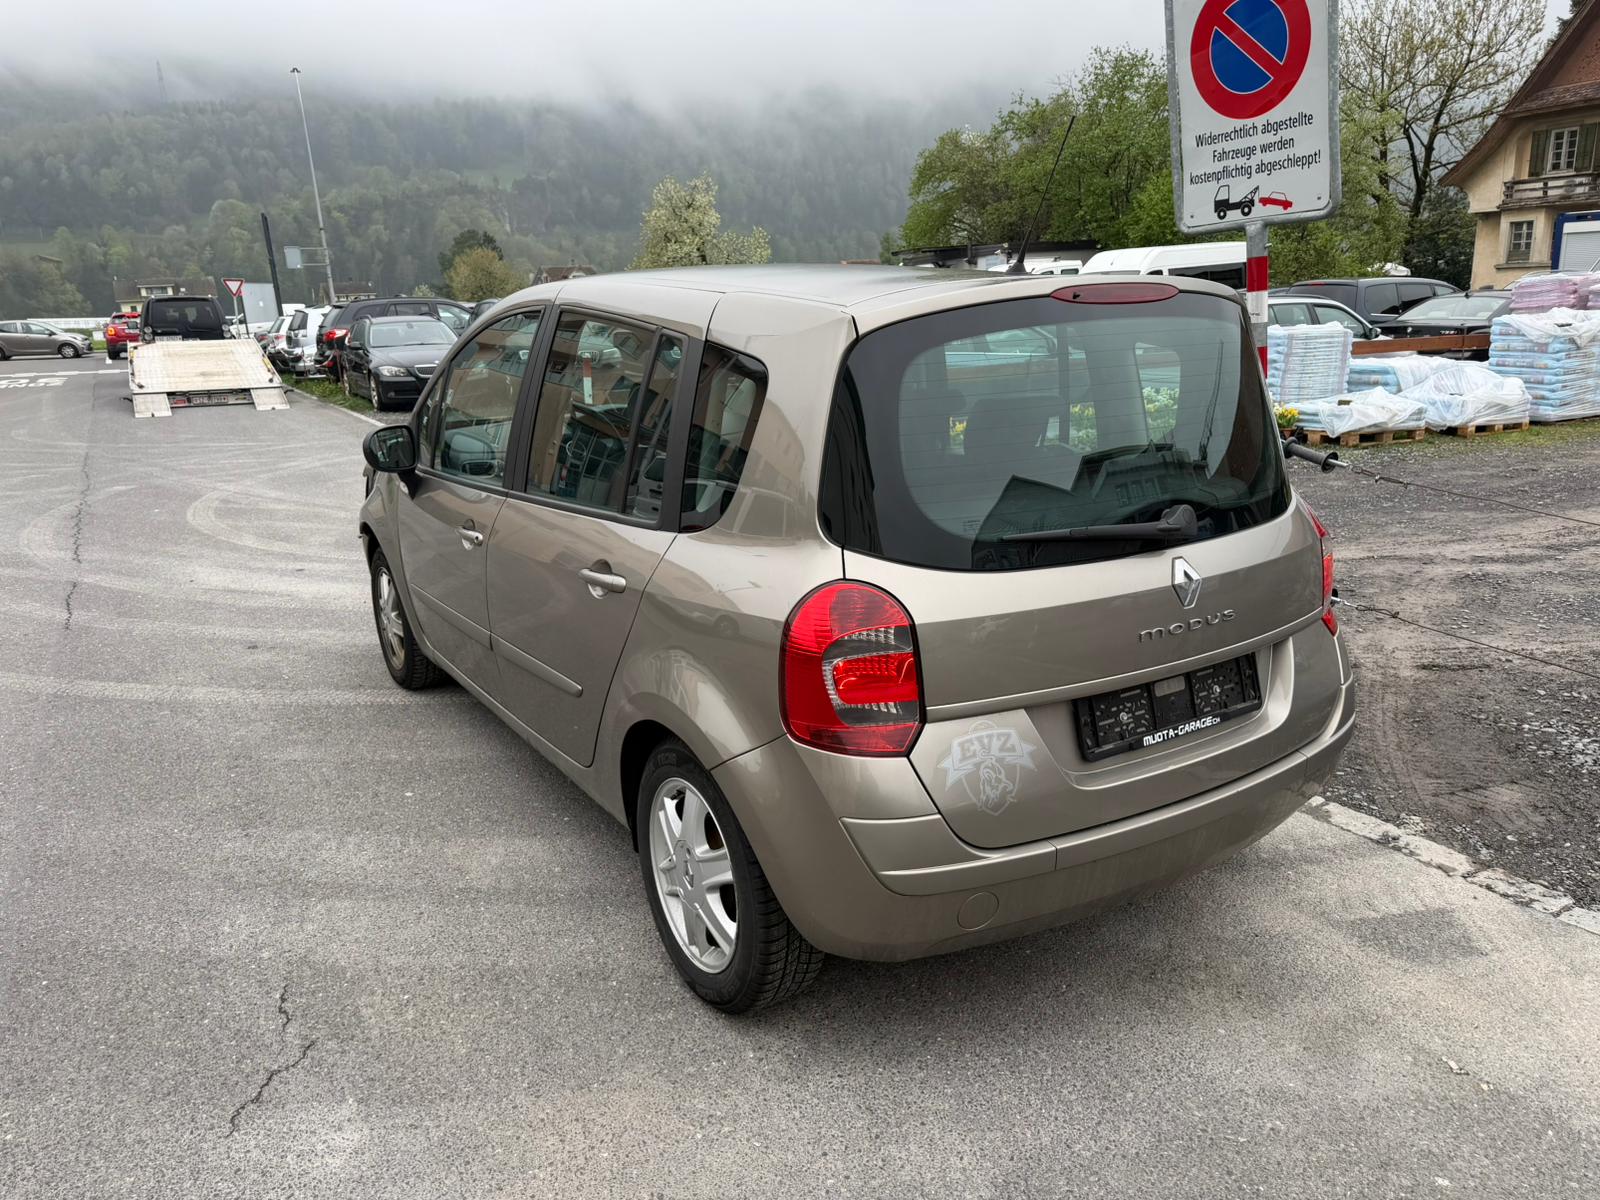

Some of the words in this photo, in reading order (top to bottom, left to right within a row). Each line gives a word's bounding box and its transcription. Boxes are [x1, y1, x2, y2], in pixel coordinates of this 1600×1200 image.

[1195, 124, 1259, 148] Widerrechtlich
[1261, 111, 1314, 137] abgestellte
[1212, 147, 1257, 164] Fahrzeuge
[1259, 136, 1295, 153] werden
[1189, 164, 1252, 186] kostenpflichtig
[1254, 149, 1321, 177] abgeschleppt!
[1138, 609, 1236, 643] MODUS
[958, 732, 1017, 760] EVZ
